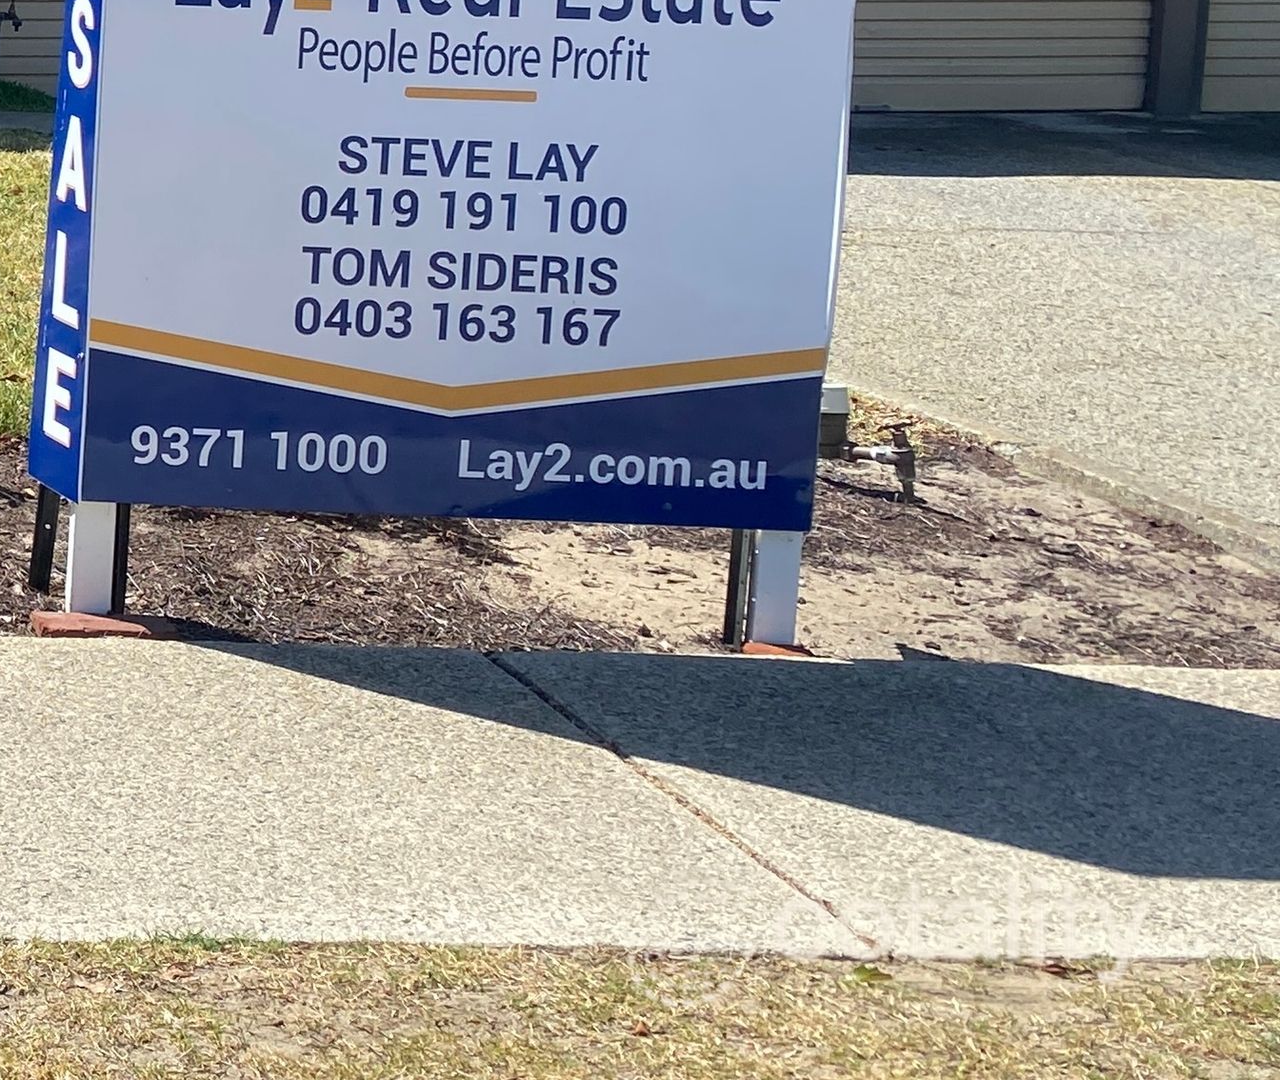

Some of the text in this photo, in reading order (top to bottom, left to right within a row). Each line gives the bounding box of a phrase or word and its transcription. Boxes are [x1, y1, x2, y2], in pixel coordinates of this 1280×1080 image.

[297, 27, 650, 83] People Before Profit
[338, 135, 599, 182] STEVE LAY
[301, 185, 628, 236] 0419 191 100
[302, 245, 619, 296] TOM SIDERIS
[294, 296, 621, 348] 0403 163 167
[131, 425, 388, 475] 9371 1000
[458, 440, 767, 491] Lay2.com.au
